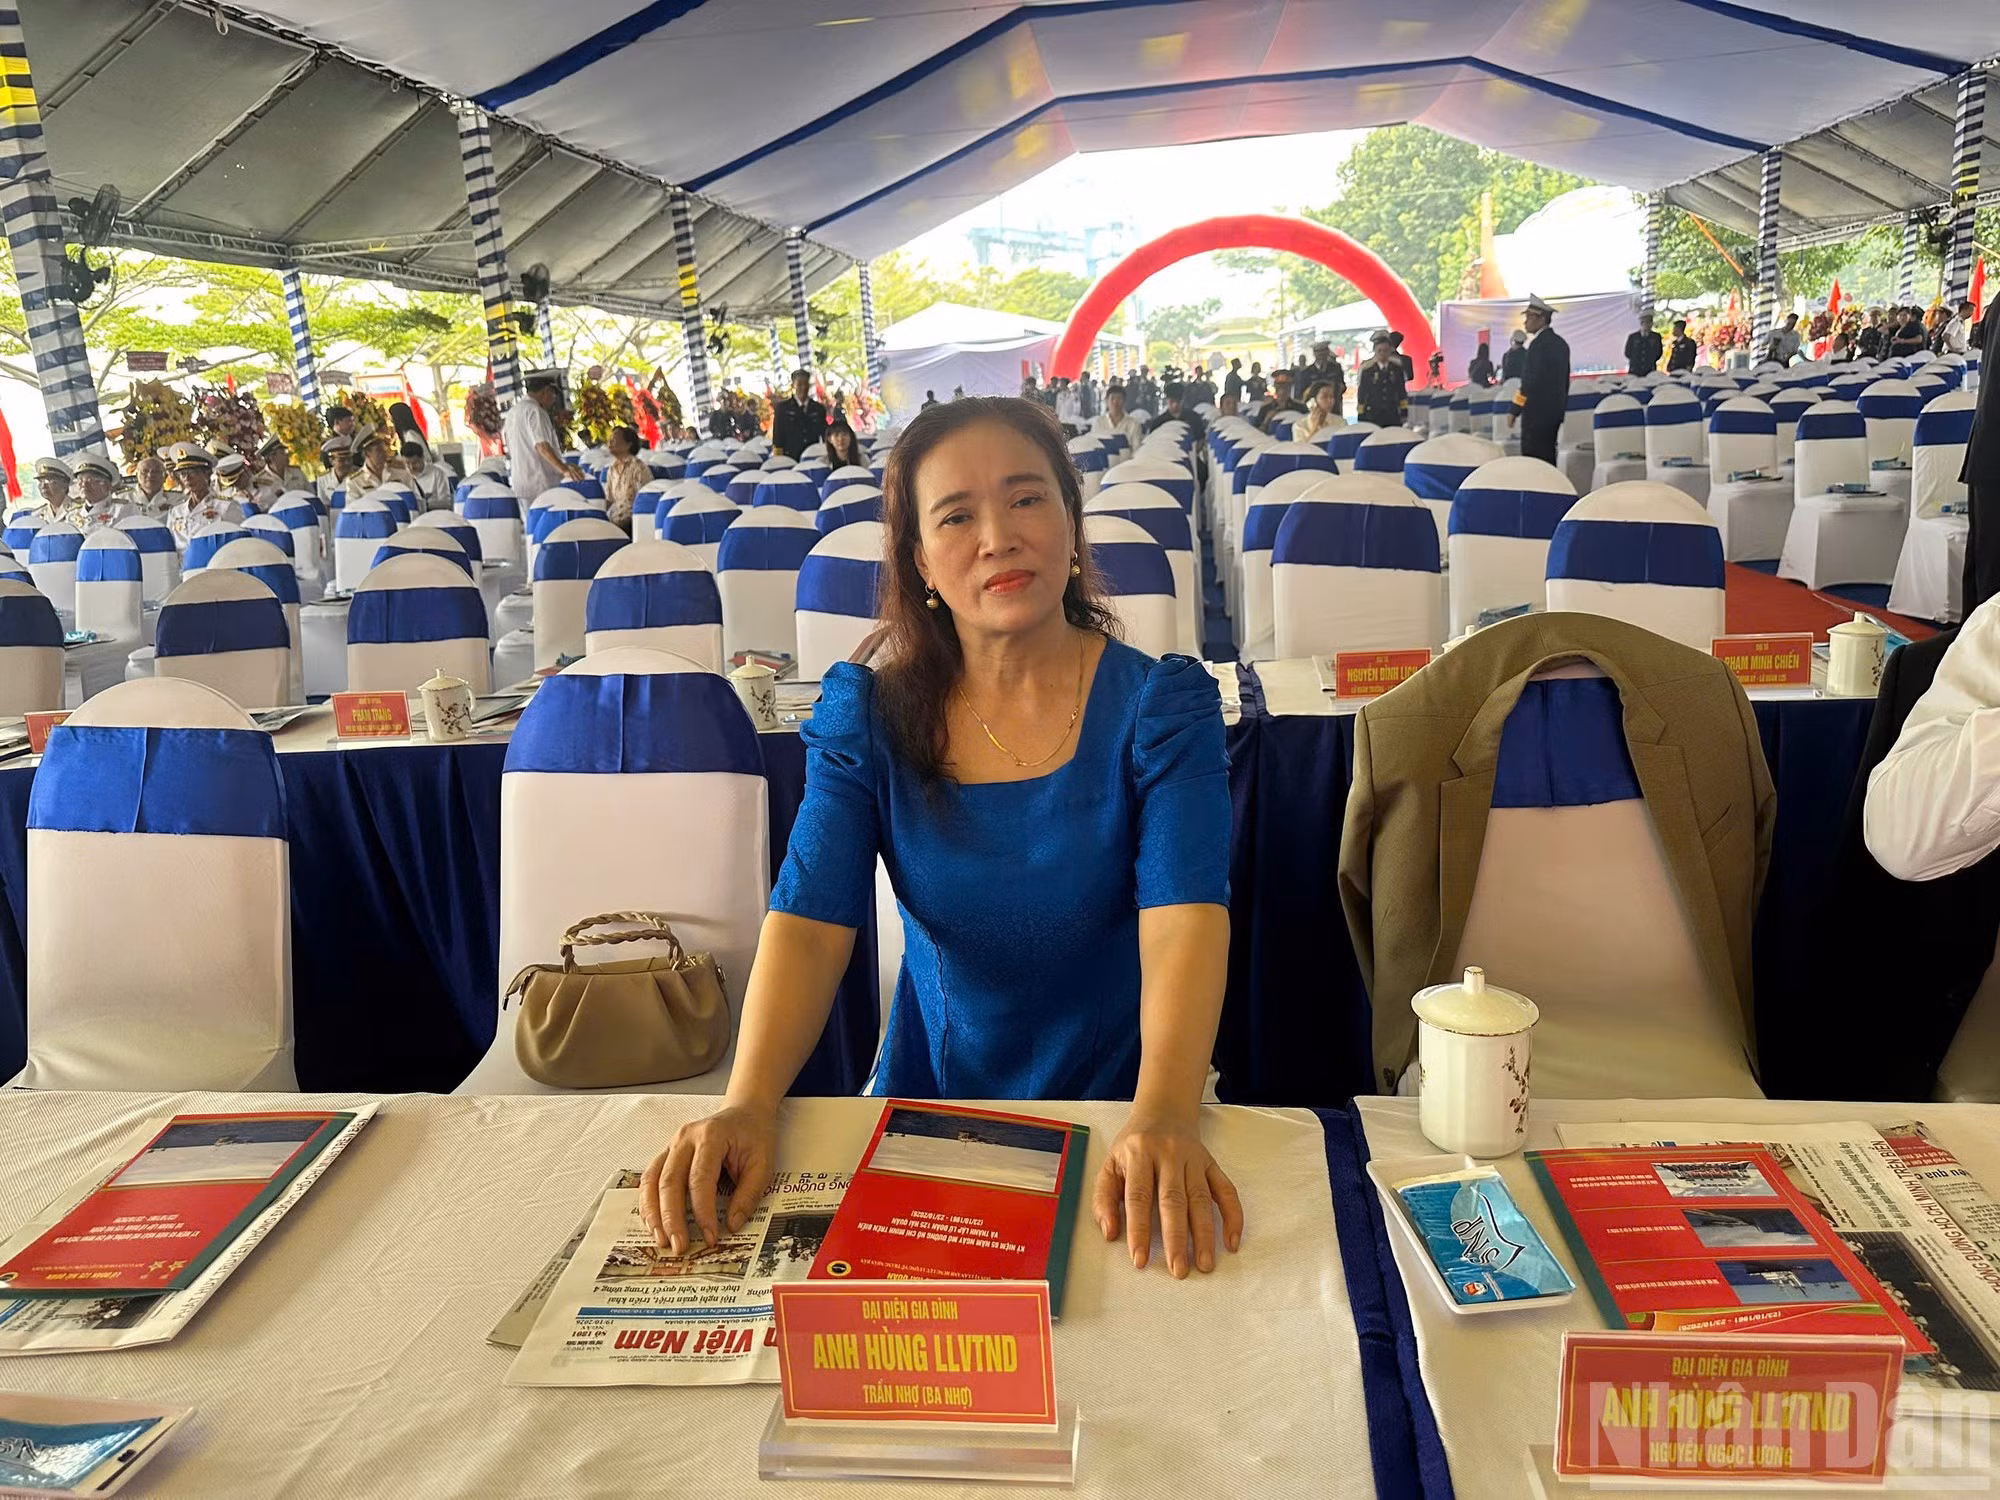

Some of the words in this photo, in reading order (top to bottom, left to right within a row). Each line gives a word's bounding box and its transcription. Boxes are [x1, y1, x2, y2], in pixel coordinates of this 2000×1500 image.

[1750, 655, 1772, 669] MINH
[1774, 649, 1800, 669] CHIẾN
[783, 1182, 826, 1194] ĐƯỜNG
[858, 1222, 874, 1233] BIỂN
[892, 1218, 908, 1227] QUÂN
[908, 1220, 920, 1228] HẢI
[920, 1220, 930, 1228] 125
[932, 1222, 949, 1232] ĐOÀN
[874, 1224, 888, 1235] TRÊN
[958, 1224, 969, 1234] LẬP
[970, 1227, 990, 1238] THÀNH
[906, 1230, 916, 1239] CHÍ
[990, 1231, 999, 1239] VÀ
[959, 1237, 976, 1248] NGÀY
[976, 1239, 990, 1249] NĂM
[1000, 1241, 1016, 1252] NIỆM
[625, 1286, 650, 1294] Trung
[652, 1286, 677, 1294] quyết
[678, 1284, 698, 1294] Nghị
[700, 1285, 720, 1294] hiện
[720, 1284, 740, 1294] thực
[608, 1297, 628, 1305] khai
[628, 1297, 650, 1306] triển
[653, 1296, 676, 1304] triệt,
[698, 1296, 719, 1304] nghị
[720, 1296, 736, 1304] Hội
[862, 1300, 882, 1324] ĐẠI
[883, 1296, 908, 1324] DIỆN
[910, 1300, 930, 1320] GIA
[931, 1297, 958, 1320] ĐÌNH
[614, 1330, 690, 1354] Nam
[692, 1325, 754, 1355] Việt
[813, 1333, 860, 1370] ANH
[864, 1326, 928, 1372] HÙNG
[934, 1334, 1018, 1372] LLVTND
[1672, 1357, 1695, 1380] ĐẠI
[1697, 1354, 1727, 1380] DIỆN
[1731, 1358, 1753, 1377] GIA
[1756, 1354, 1790, 1378] ĐÌNH
[894, 1384, 920, 1408] NHỢ
[922, 1386, 942, 1406] (BA
[944, 1386, 972, 1410] NHỢ)
[1602, 1387, 1660, 1428] ANH
[1668, 1381, 1743, 1430] HÙNG
[1750, 1391, 1851, 1432] LLVTND
[1649, 1437, 1703, 1464] NGUYỄN
[1707, 1444, 1745, 1470] NGỌC
